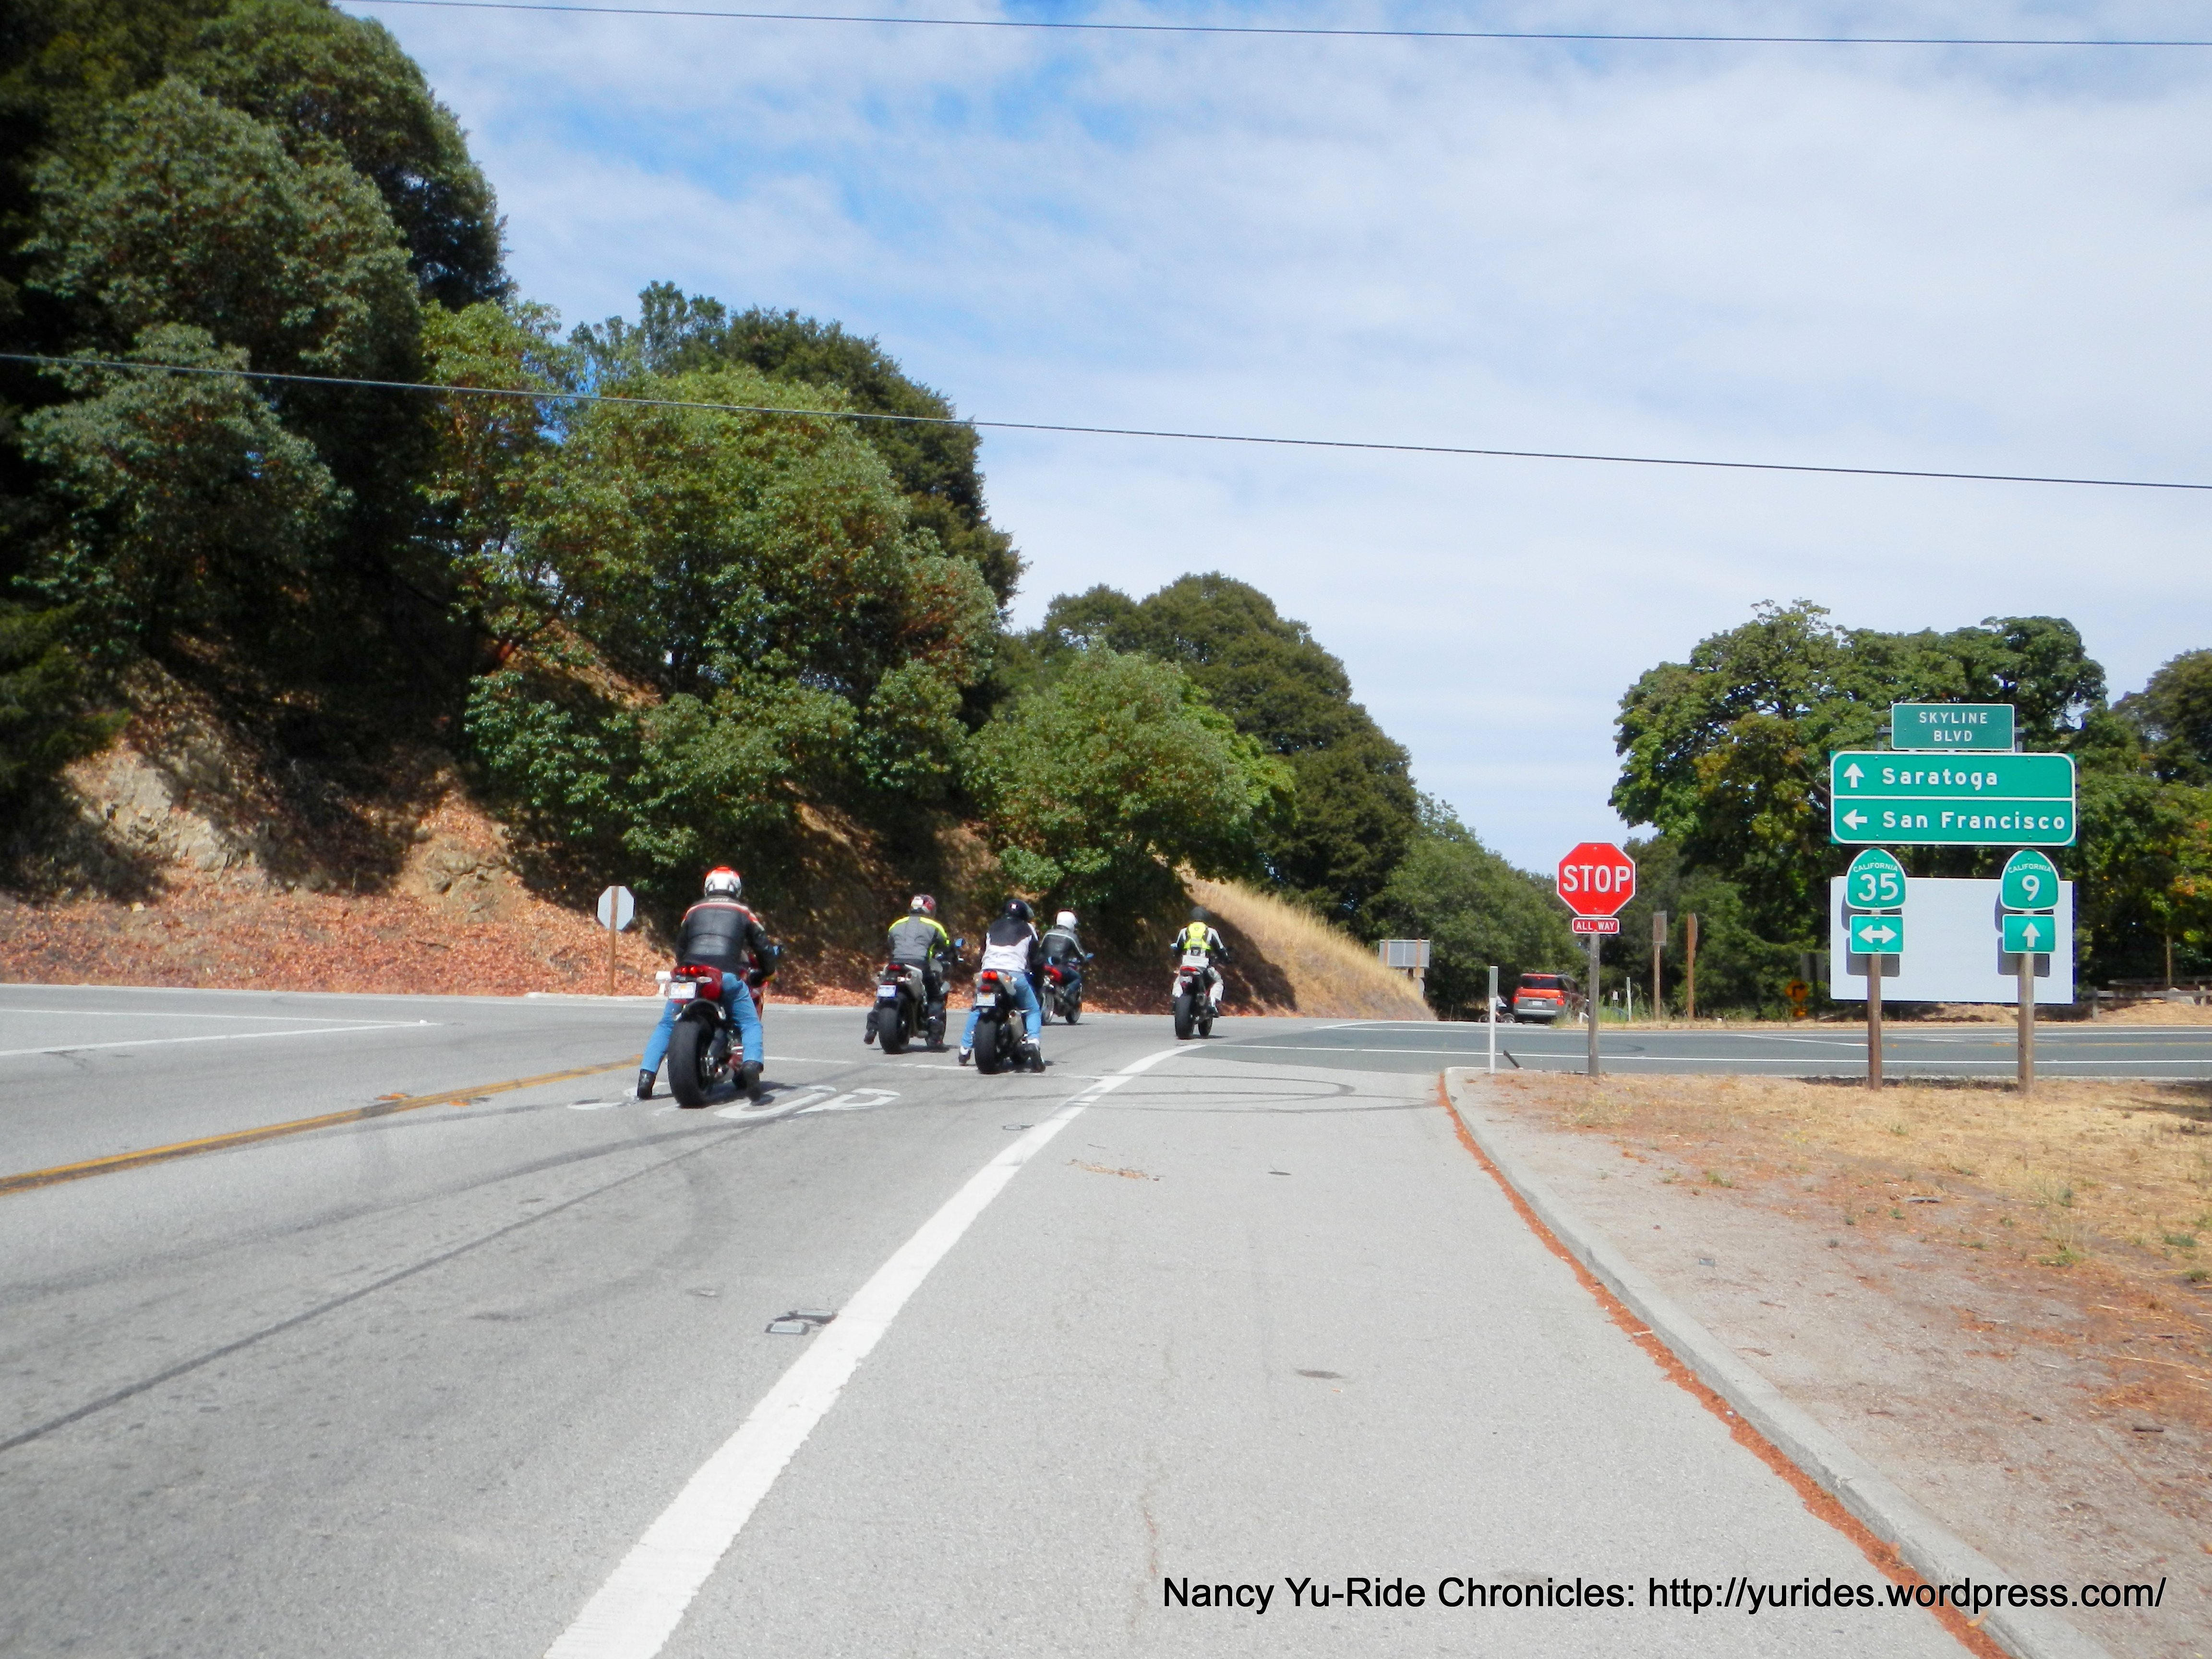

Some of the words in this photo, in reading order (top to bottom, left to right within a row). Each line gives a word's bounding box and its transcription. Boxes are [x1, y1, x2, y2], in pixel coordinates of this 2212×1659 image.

[1919, 712, 1988, 724] SKYLINE
[1934, 730, 1972, 742] BLVD
[1882, 768, 1997, 791] Saratoga
[1883, 811, 1928, 828] San
[1941, 811, 2065, 830] Francisco
[1853, 862, 1898, 873] CALIFORNIA
[2008, 863, 2052, 873] CALIFORNIA
[1563, 865, 1631, 892] STOP
[1858, 873, 1899, 901] 35
[2021, 875, 2040, 902] 9
[1576, 921, 1593, 930] ALL
[1598, 921, 1615, 930] WAY
